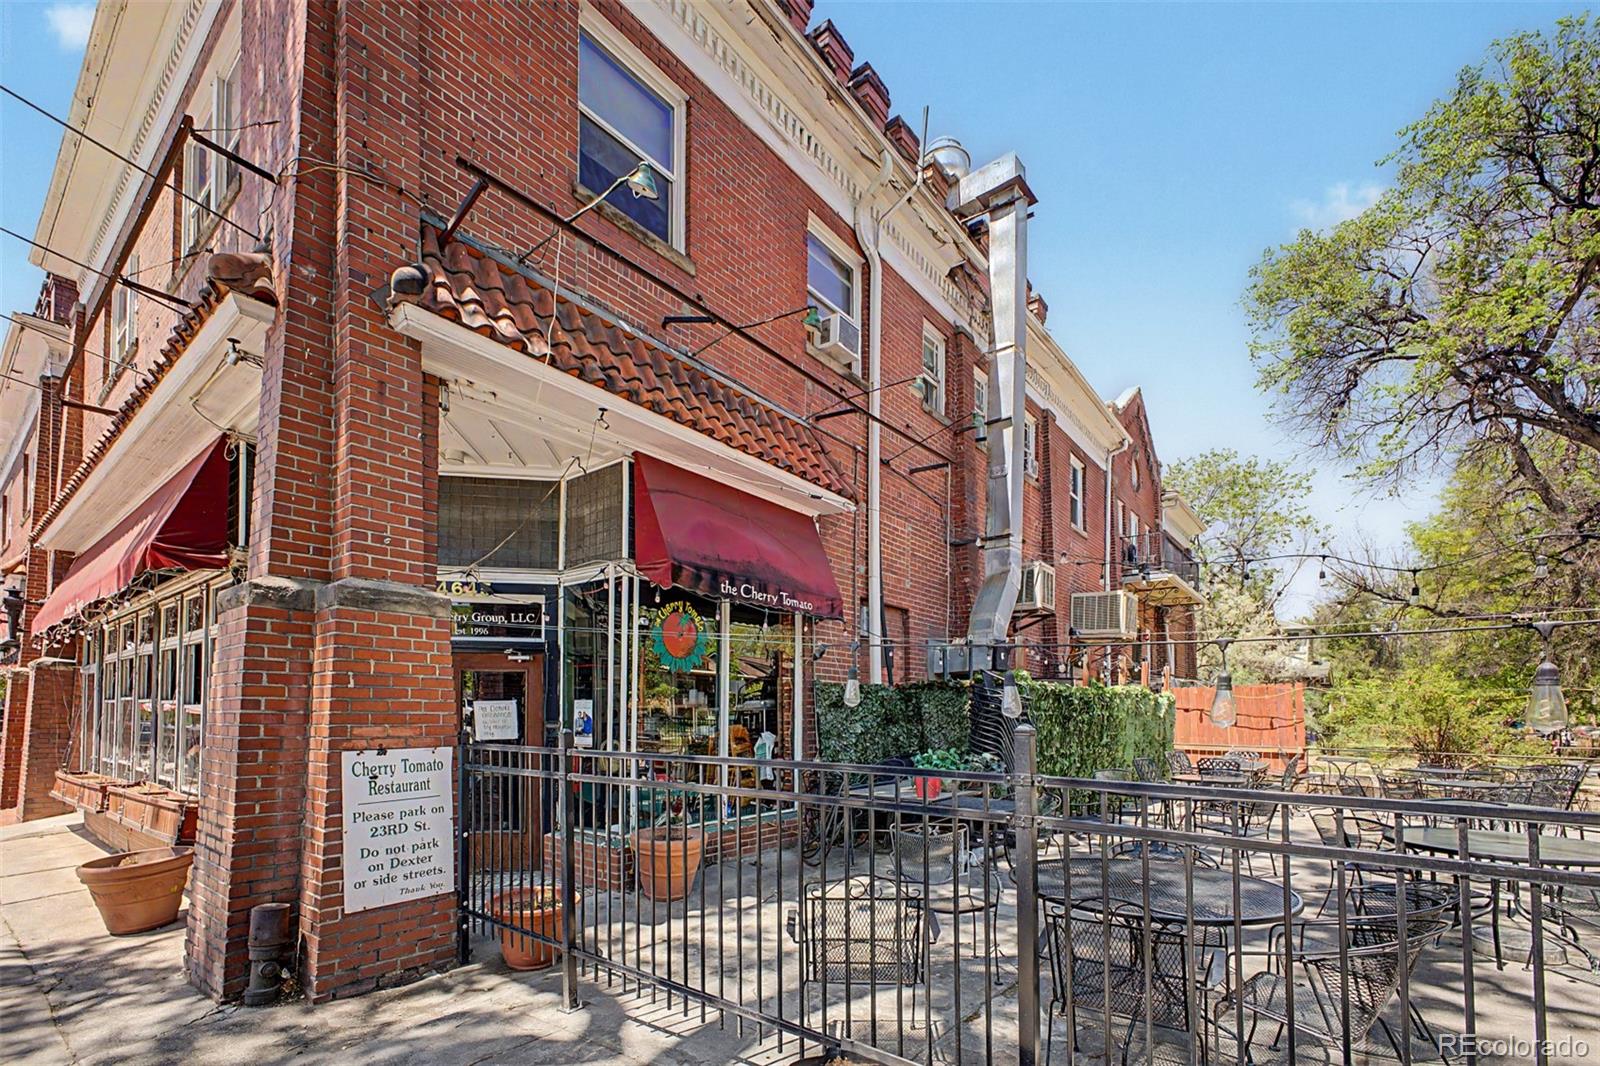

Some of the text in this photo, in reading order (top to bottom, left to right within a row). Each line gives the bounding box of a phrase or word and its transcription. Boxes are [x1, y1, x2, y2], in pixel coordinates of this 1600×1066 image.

[720, 580, 738, 596] the
[740, 583, 778, 605] Cherry
[471, 612, 508, 625] Group,
[510, 612, 535, 624] LLC
[470, 627, 489, 636] 1996
[351, 758, 444, 778] Cherry Tomato
[368, 777, 431, 796] Restaurant
[352, 805, 445, 824] Please park on
[370, 820, 431, 838] 23RD St.
[360, 837, 439, 860] Do not park
[367, 854, 433, 872] on Dexter
[353, 866, 447, 890] or side streets.
[399, 884, 426, 896] Thank
